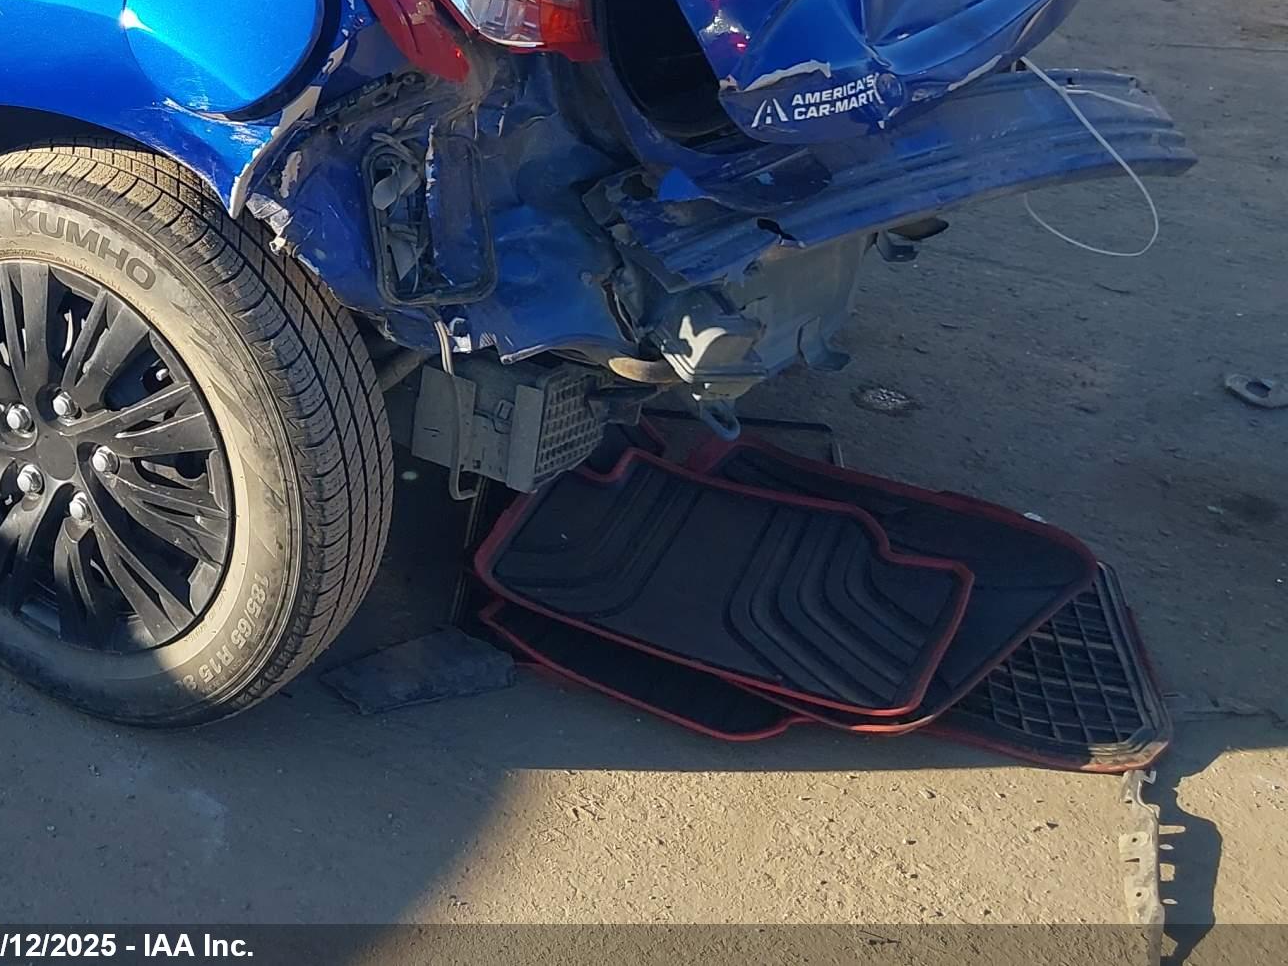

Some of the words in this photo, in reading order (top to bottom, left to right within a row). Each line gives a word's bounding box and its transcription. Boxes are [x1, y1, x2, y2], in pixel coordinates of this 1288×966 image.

[791, 75, 875, 106] AMERICA'S
[793, 90, 875, 121] CAR-MART
[12, 208, 157, 291] KUMHO
[230, 572, 270, 650] 185/65
[198, 644, 235, 684] R15
